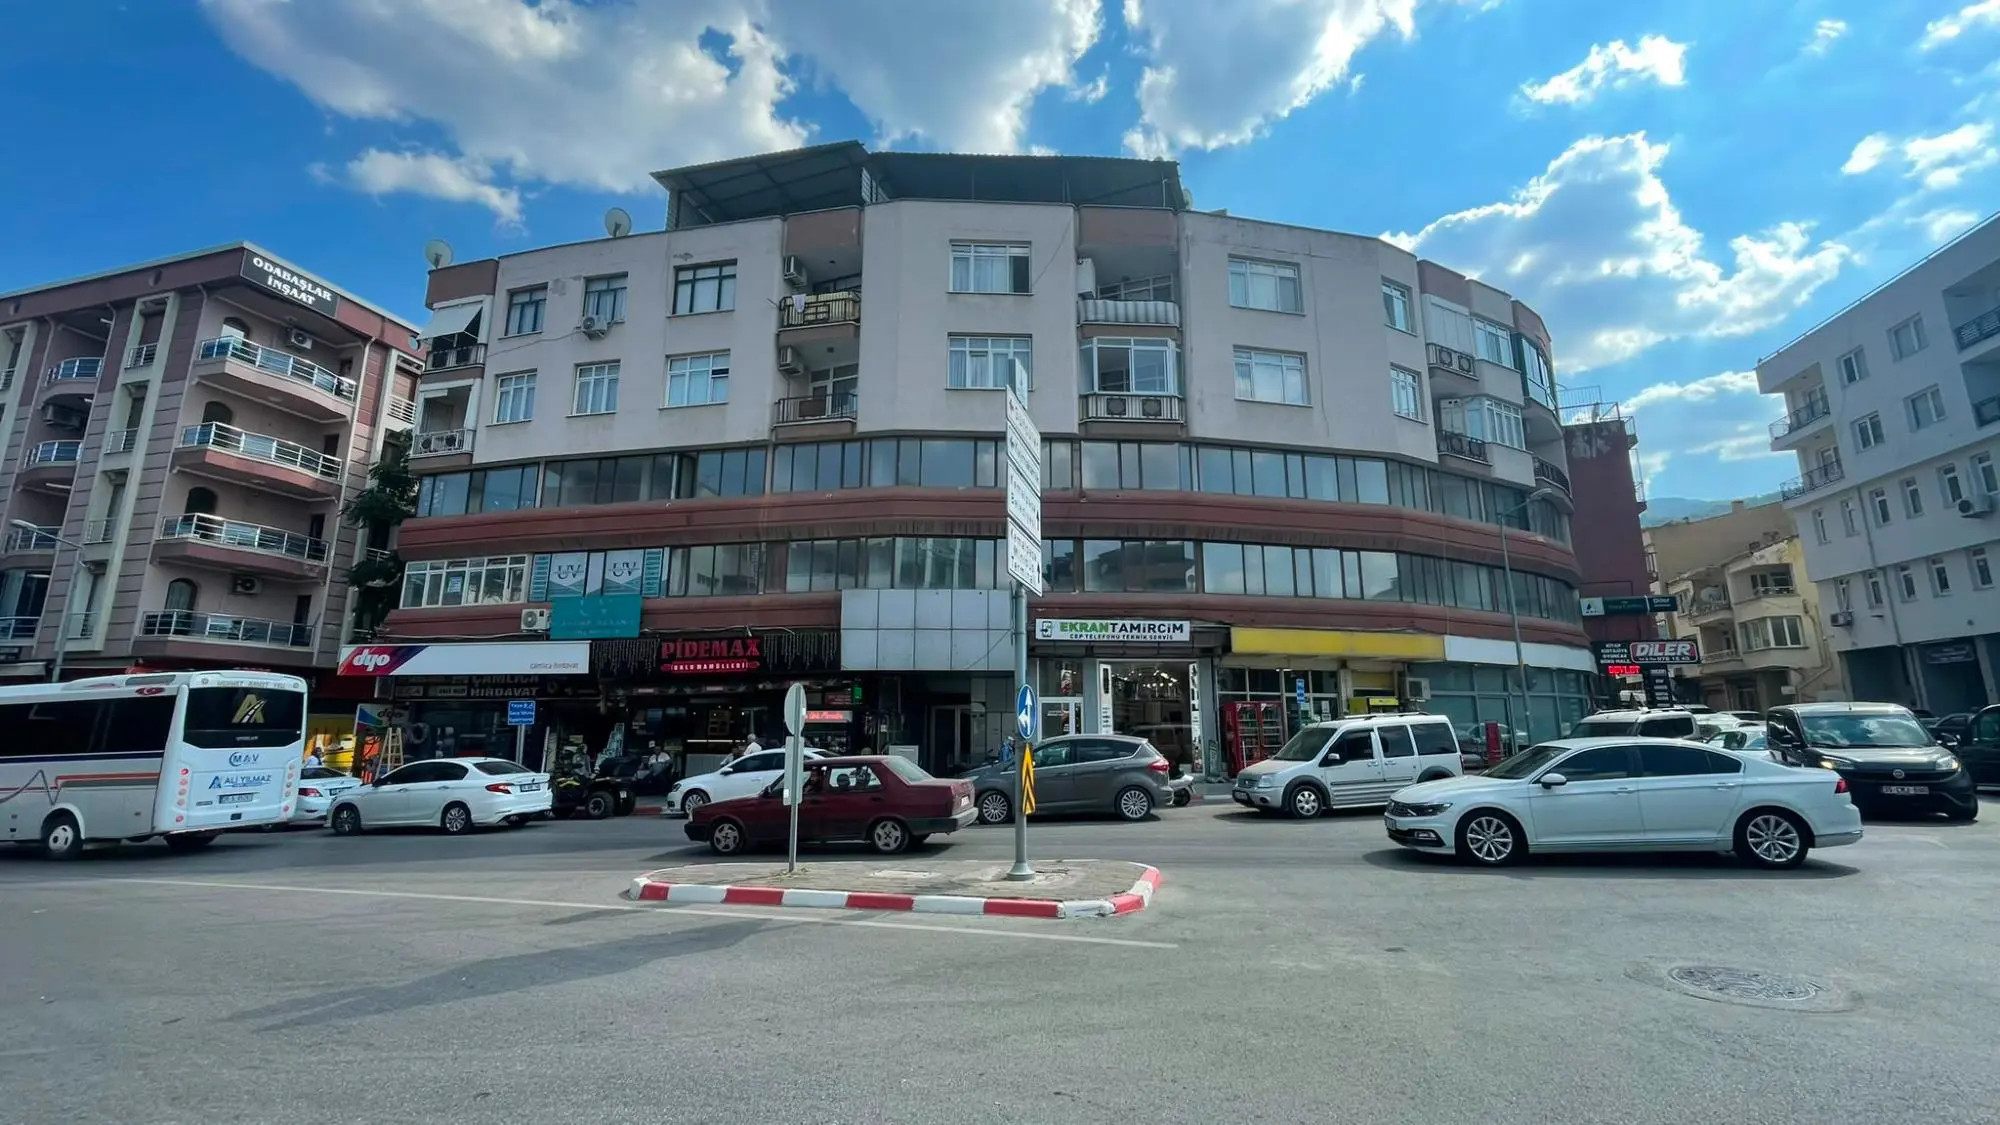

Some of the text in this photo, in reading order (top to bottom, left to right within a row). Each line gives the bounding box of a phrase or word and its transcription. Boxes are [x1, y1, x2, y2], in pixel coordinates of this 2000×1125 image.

[253, 257, 332, 302] ODABAŞLAR
[267, 275, 316, 305] İNŞAAT
[352, 648, 391, 672] dyo
[661, 639, 760, 659] PİDEMAX
[470, 687, 539, 697] HIRDAVAT
